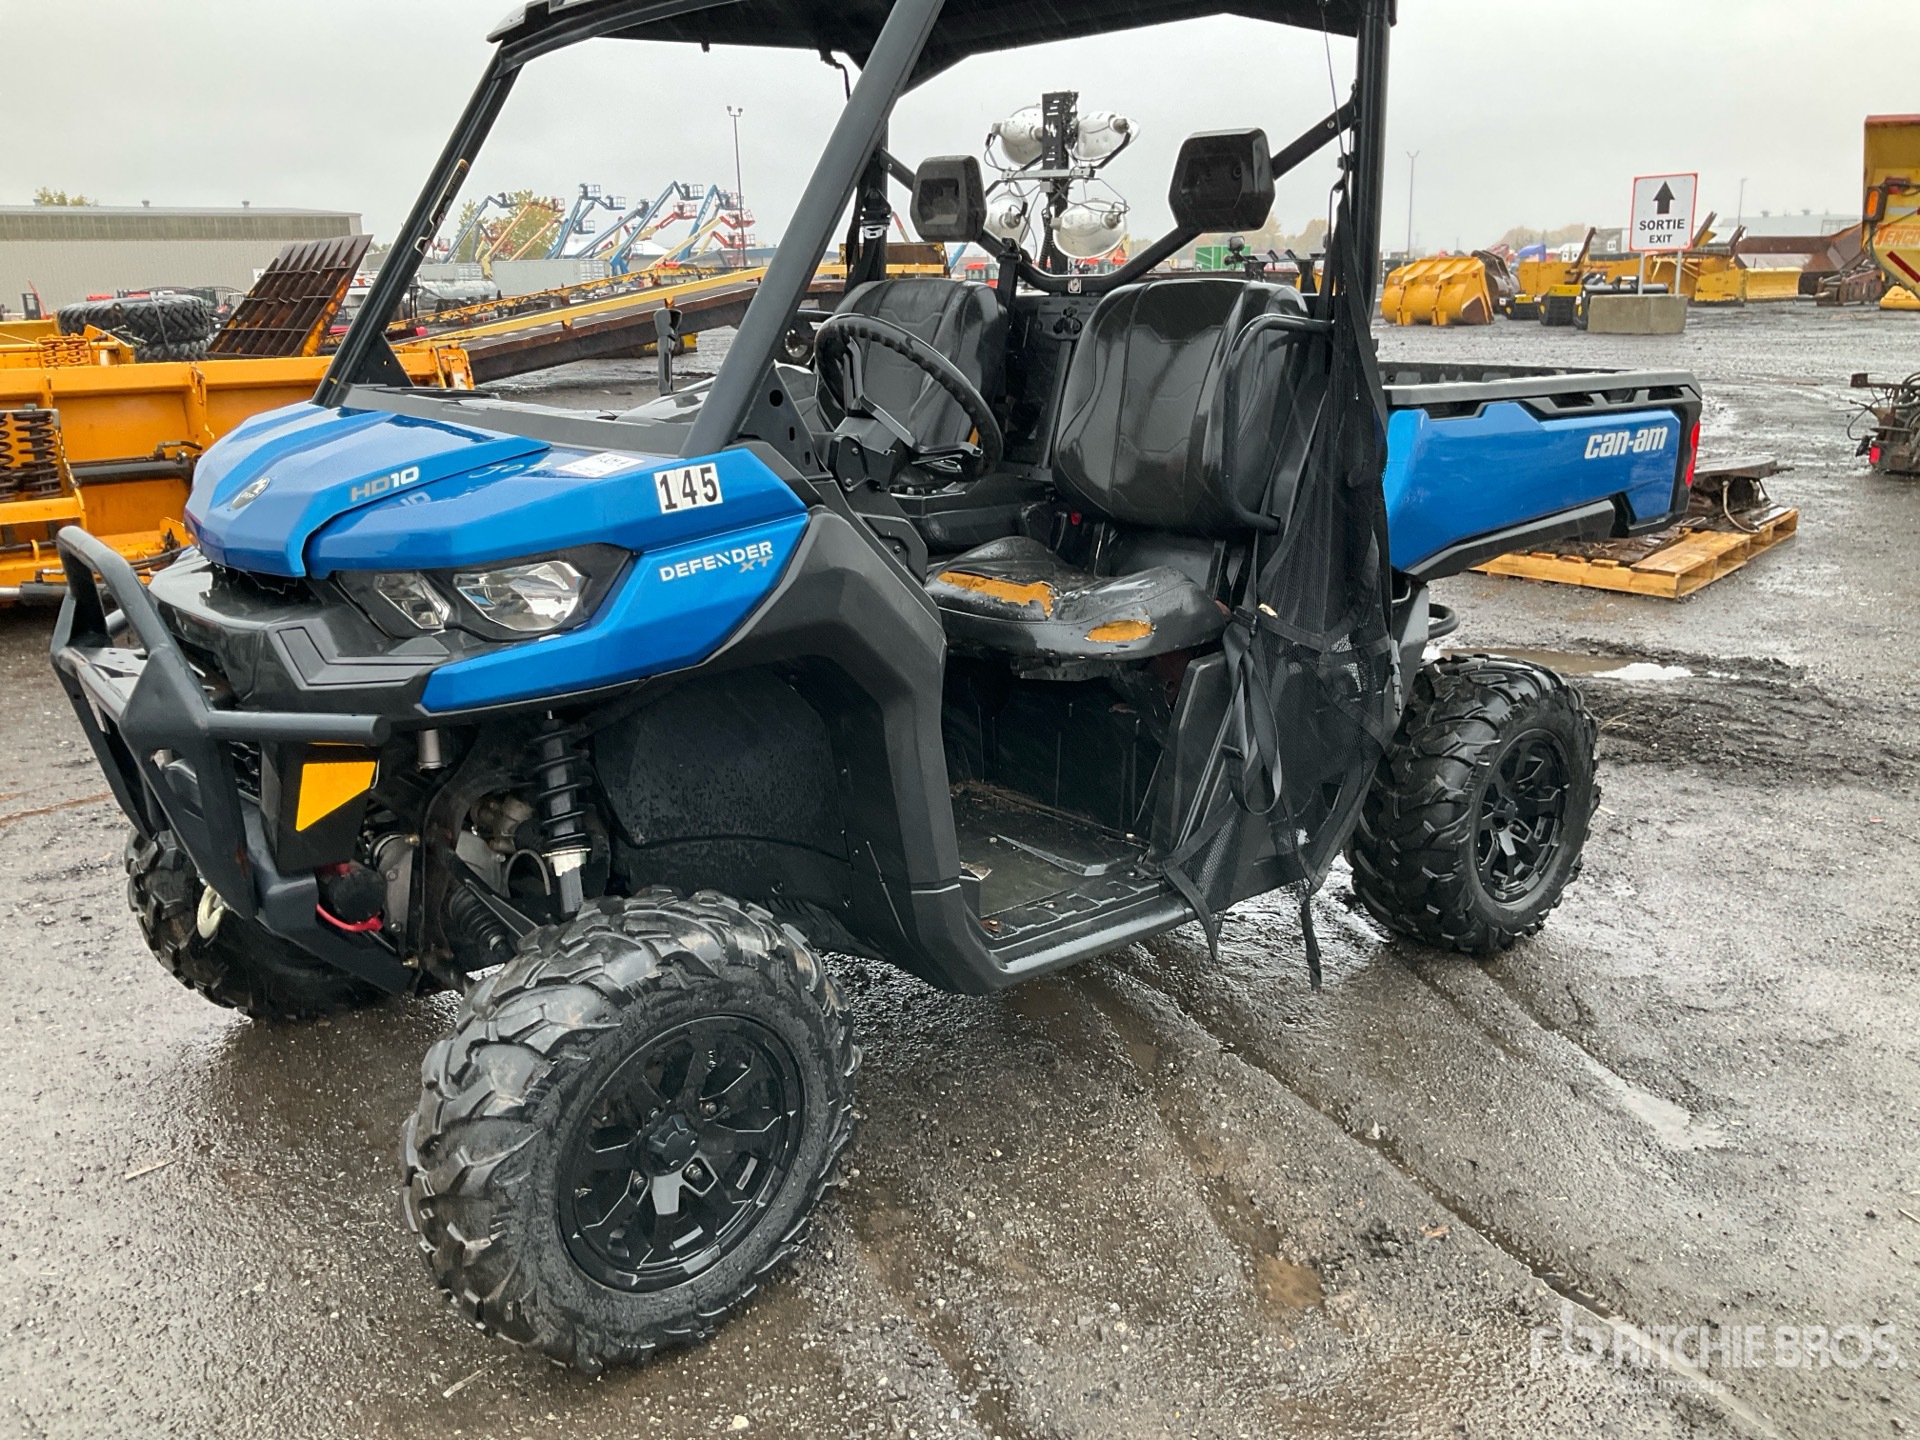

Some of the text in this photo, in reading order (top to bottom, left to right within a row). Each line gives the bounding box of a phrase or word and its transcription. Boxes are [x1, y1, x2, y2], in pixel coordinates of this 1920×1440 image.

[1639, 218, 1686, 231] SORTIE
[1649, 234, 1673, 243] EXIT
[1584, 426, 1669, 460] can-am
[350, 466, 420, 502] HD10
[659, 466, 718, 511] 145
[659, 541, 774, 581] DEFENDER
[739, 555, 774, 573] XT
